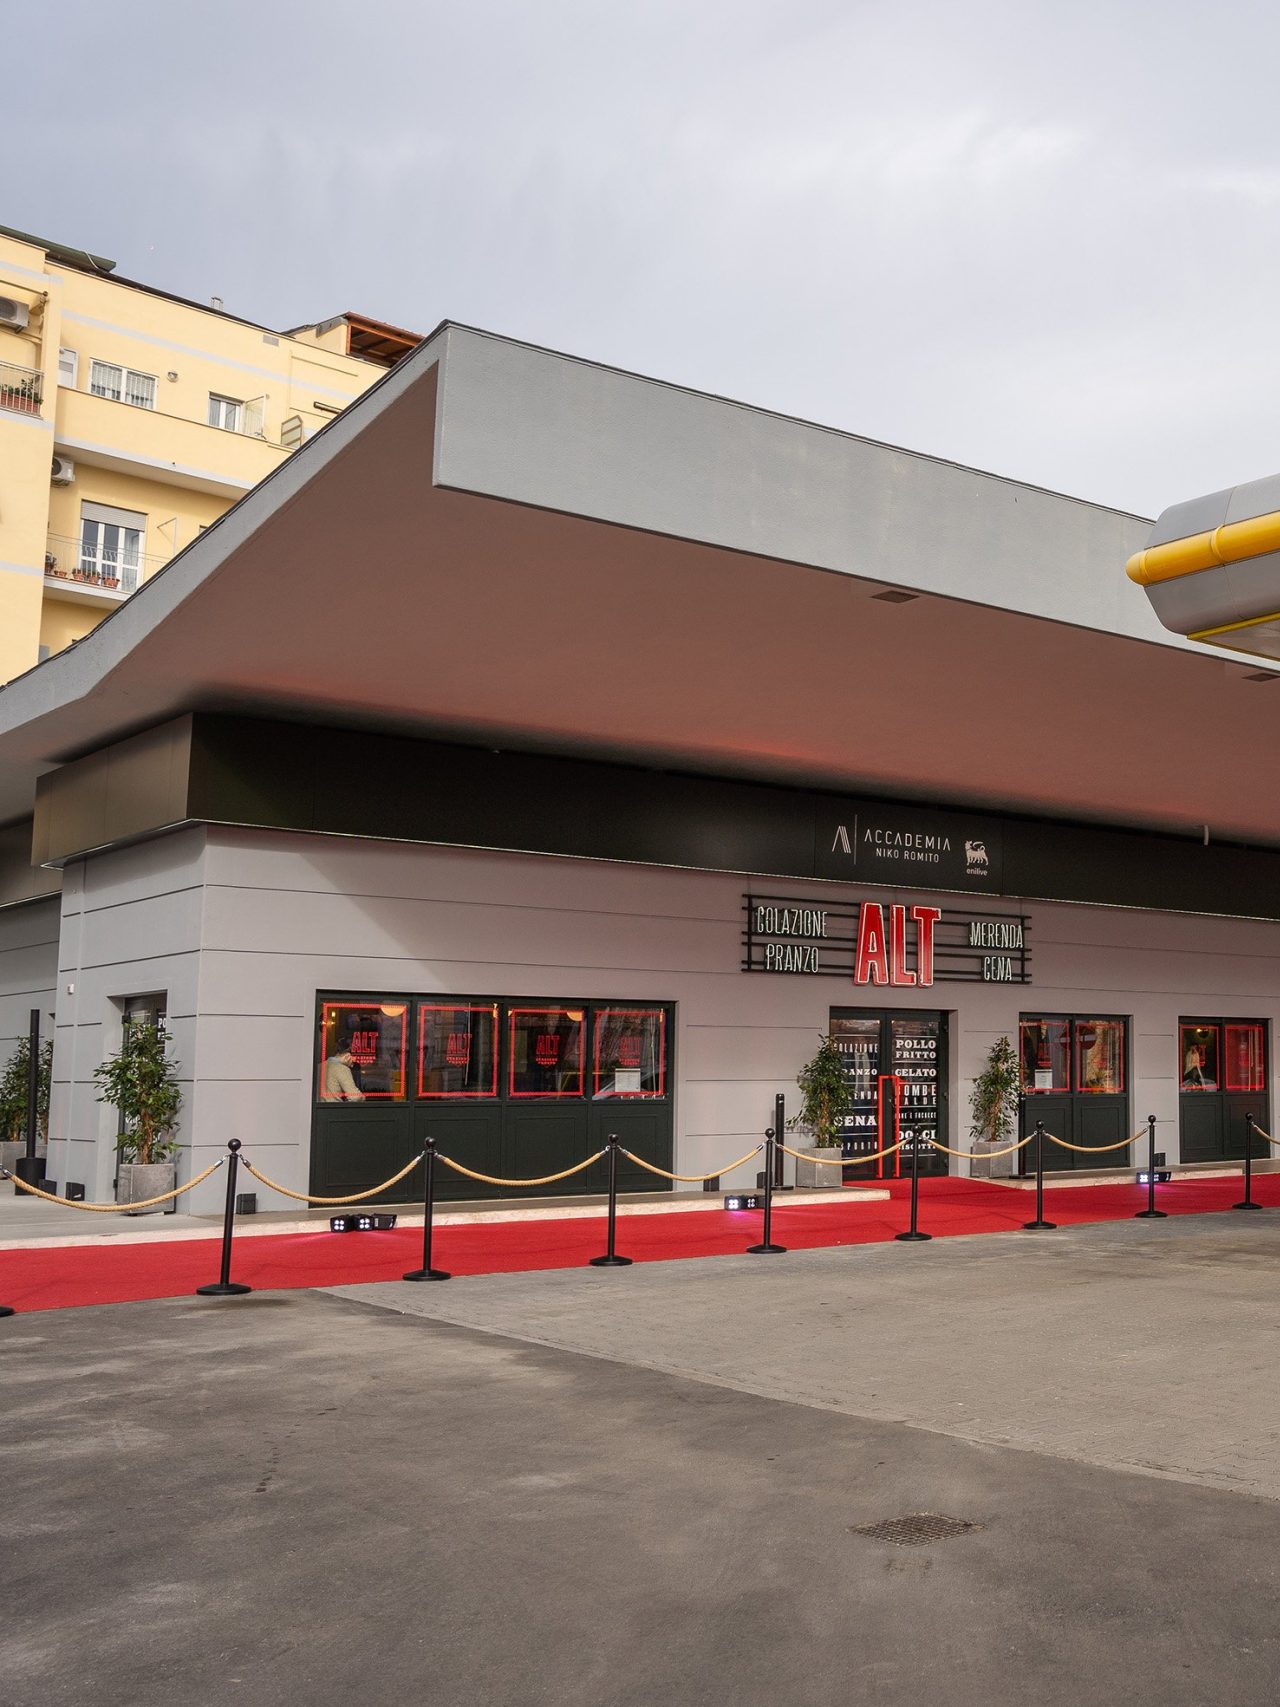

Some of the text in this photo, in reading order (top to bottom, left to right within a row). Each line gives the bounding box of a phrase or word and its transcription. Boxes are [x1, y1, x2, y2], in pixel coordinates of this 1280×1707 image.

[864, 828, 951, 851] ACCADEMIA
[876, 847, 940, 863] NIKO ROMITO
[966, 867, 988, 877] enilive
[757, 906, 828, 938] COLAZIONE
[854, 901, 941, 988] ALT
[969, 921, 1024, 949] MERENDA
[766, 943, 819, 973] PRANZO
[983, 956, 1013, 981] CENA
[351, 1031, 379, 1053] ALT
[536, 1035, 560, 1055] ALT
[895, 1039, 937, 1049] POLLO
[895, 1050, 937, 1059] FRITTO
[894, 1068, 937, 1077] GELATO
